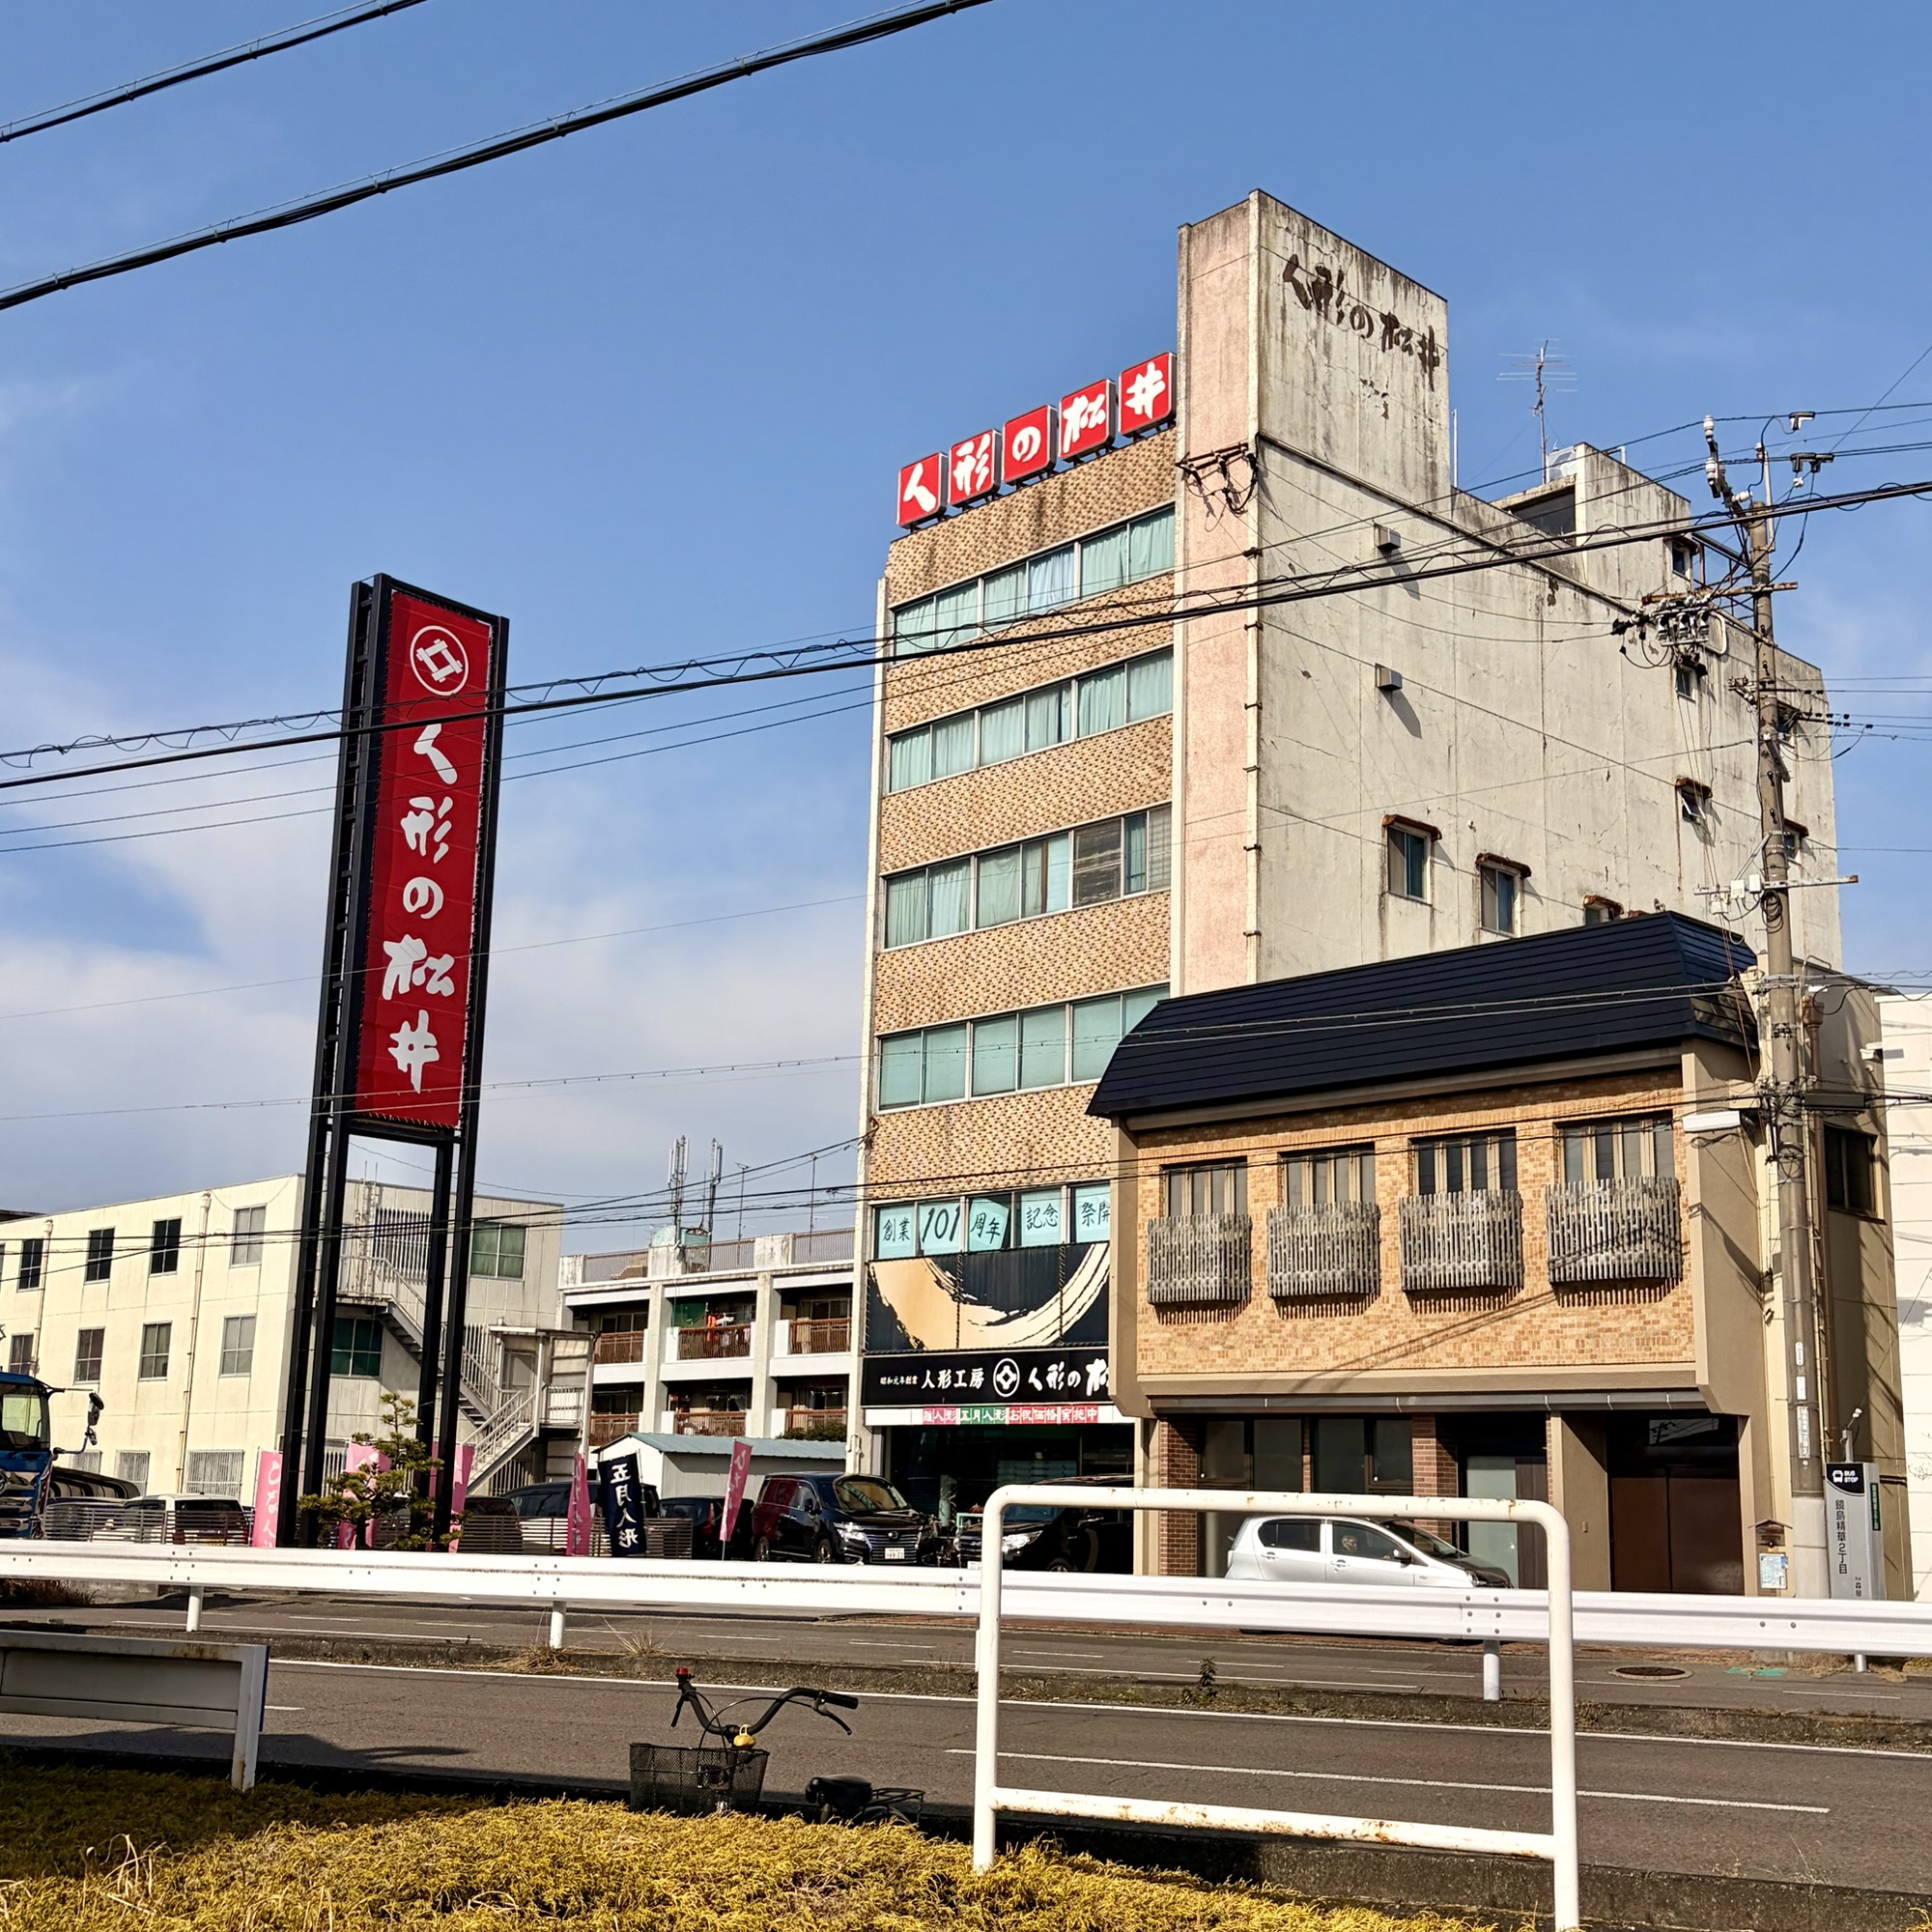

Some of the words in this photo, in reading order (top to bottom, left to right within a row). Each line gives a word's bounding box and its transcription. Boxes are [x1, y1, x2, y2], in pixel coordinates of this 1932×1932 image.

[903, 361, 1166, 512] 人形の松井
[382, 724, 458, 1094] 人形の松井
[921, 1367, 984, 1389] 人形工房
[960, 1408, 1007, 1423] 五月人形
[1062, 1406, 1097, 1421] 実施中
